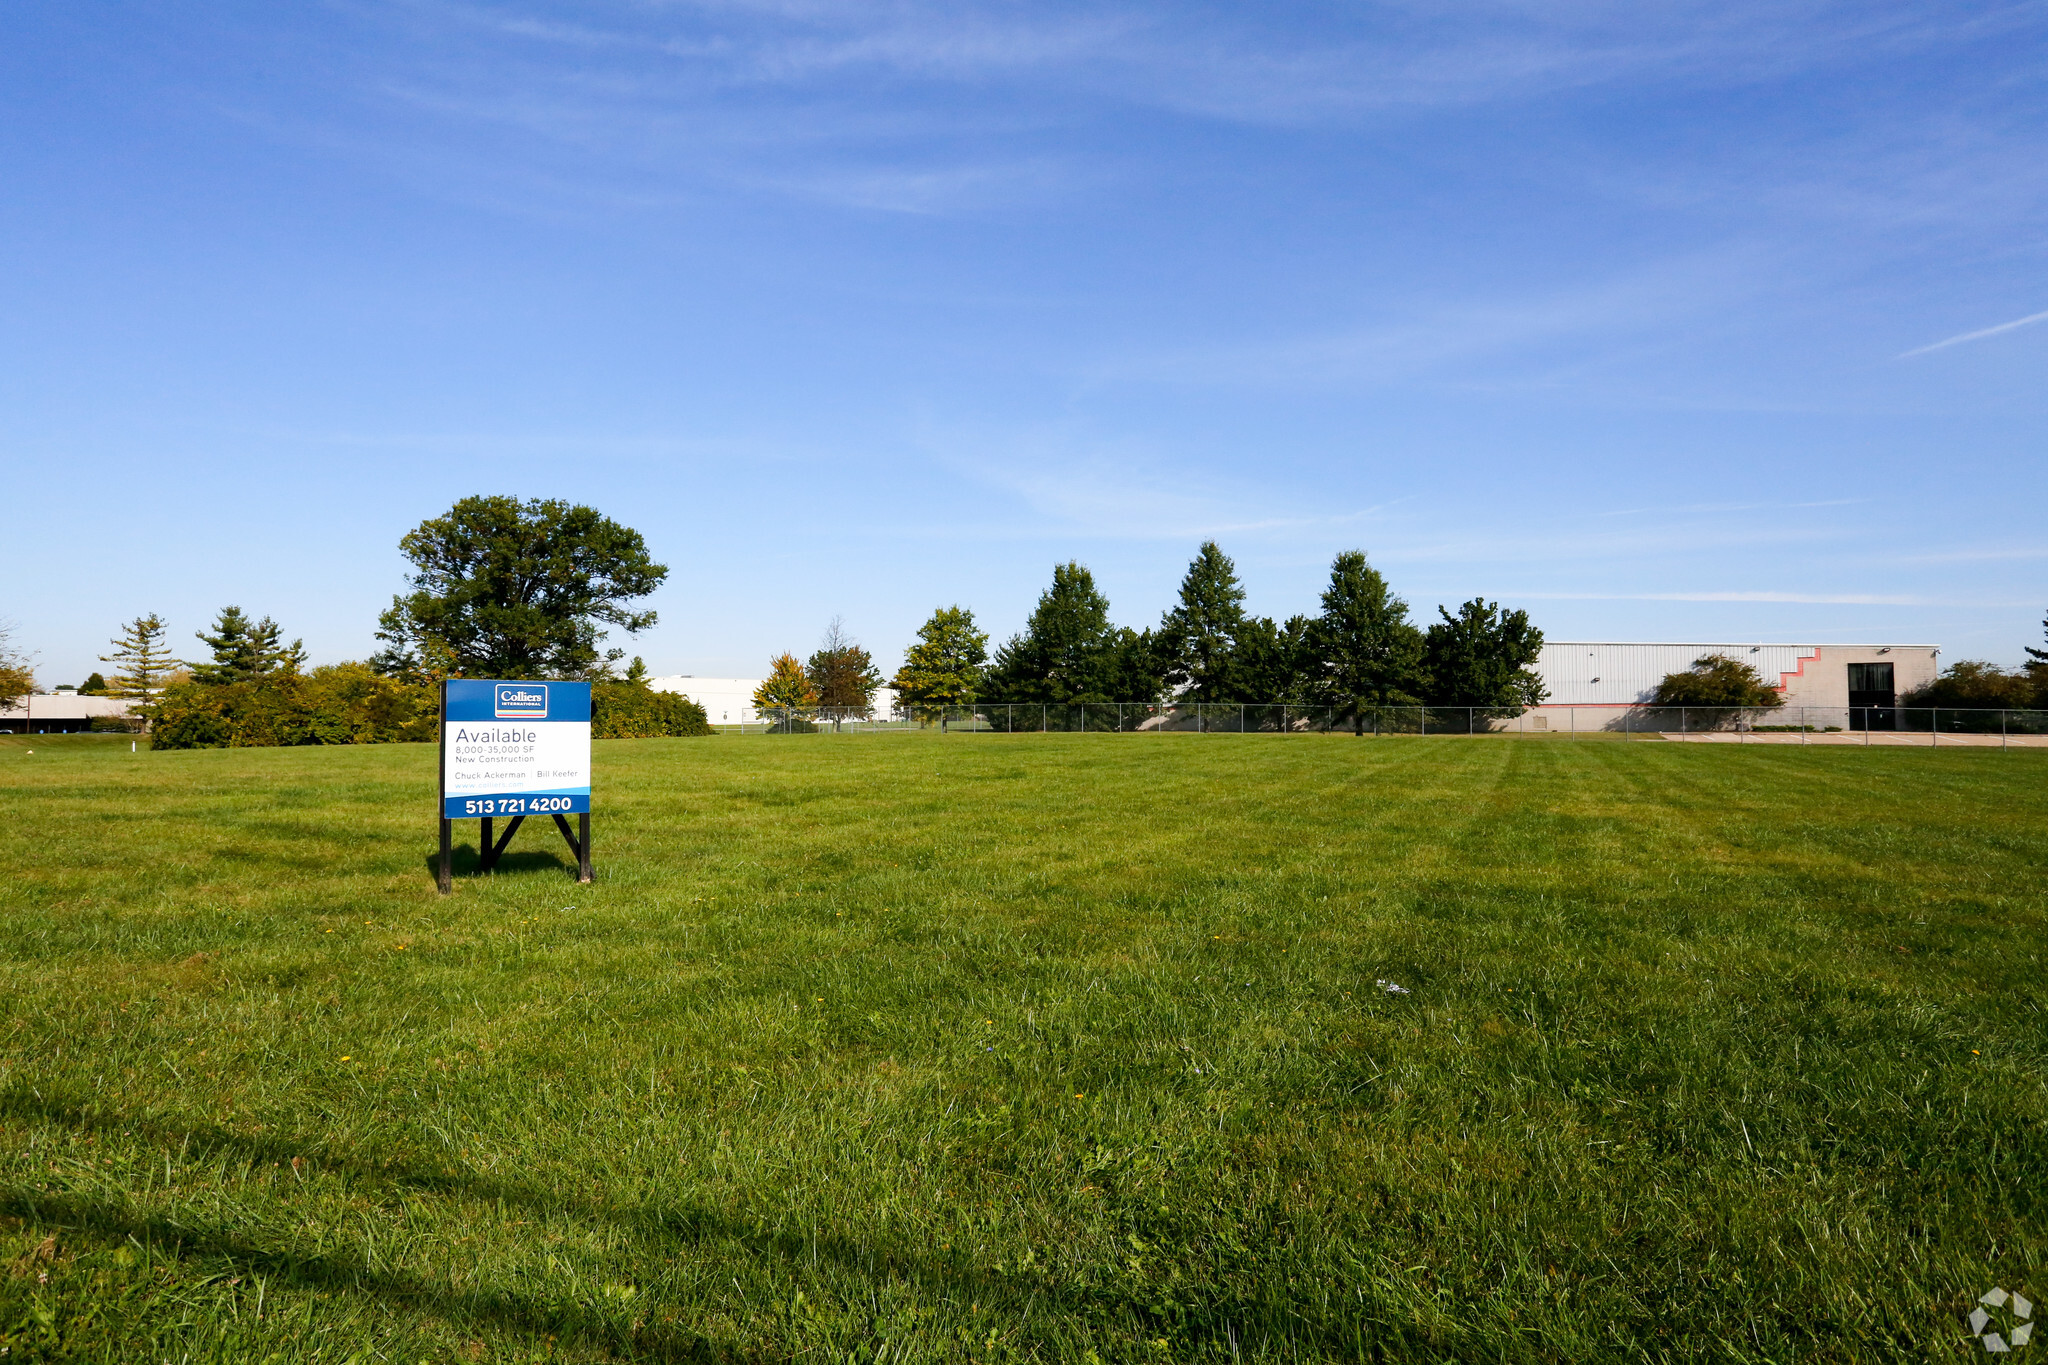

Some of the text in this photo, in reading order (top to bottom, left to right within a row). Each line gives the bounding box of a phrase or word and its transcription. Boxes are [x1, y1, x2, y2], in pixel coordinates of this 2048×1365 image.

[501, 690, 542, 702] Colliers
[456, 728, 536, 743] Available
[523, 745, 534, 753] SF
[479, 755, 535, 763] Construction
[455, 771, 526, 780] Chuck Ackerman
[537, 770, 550, 778] Bill
[466, 797, 572, 814] 513 721 4200
